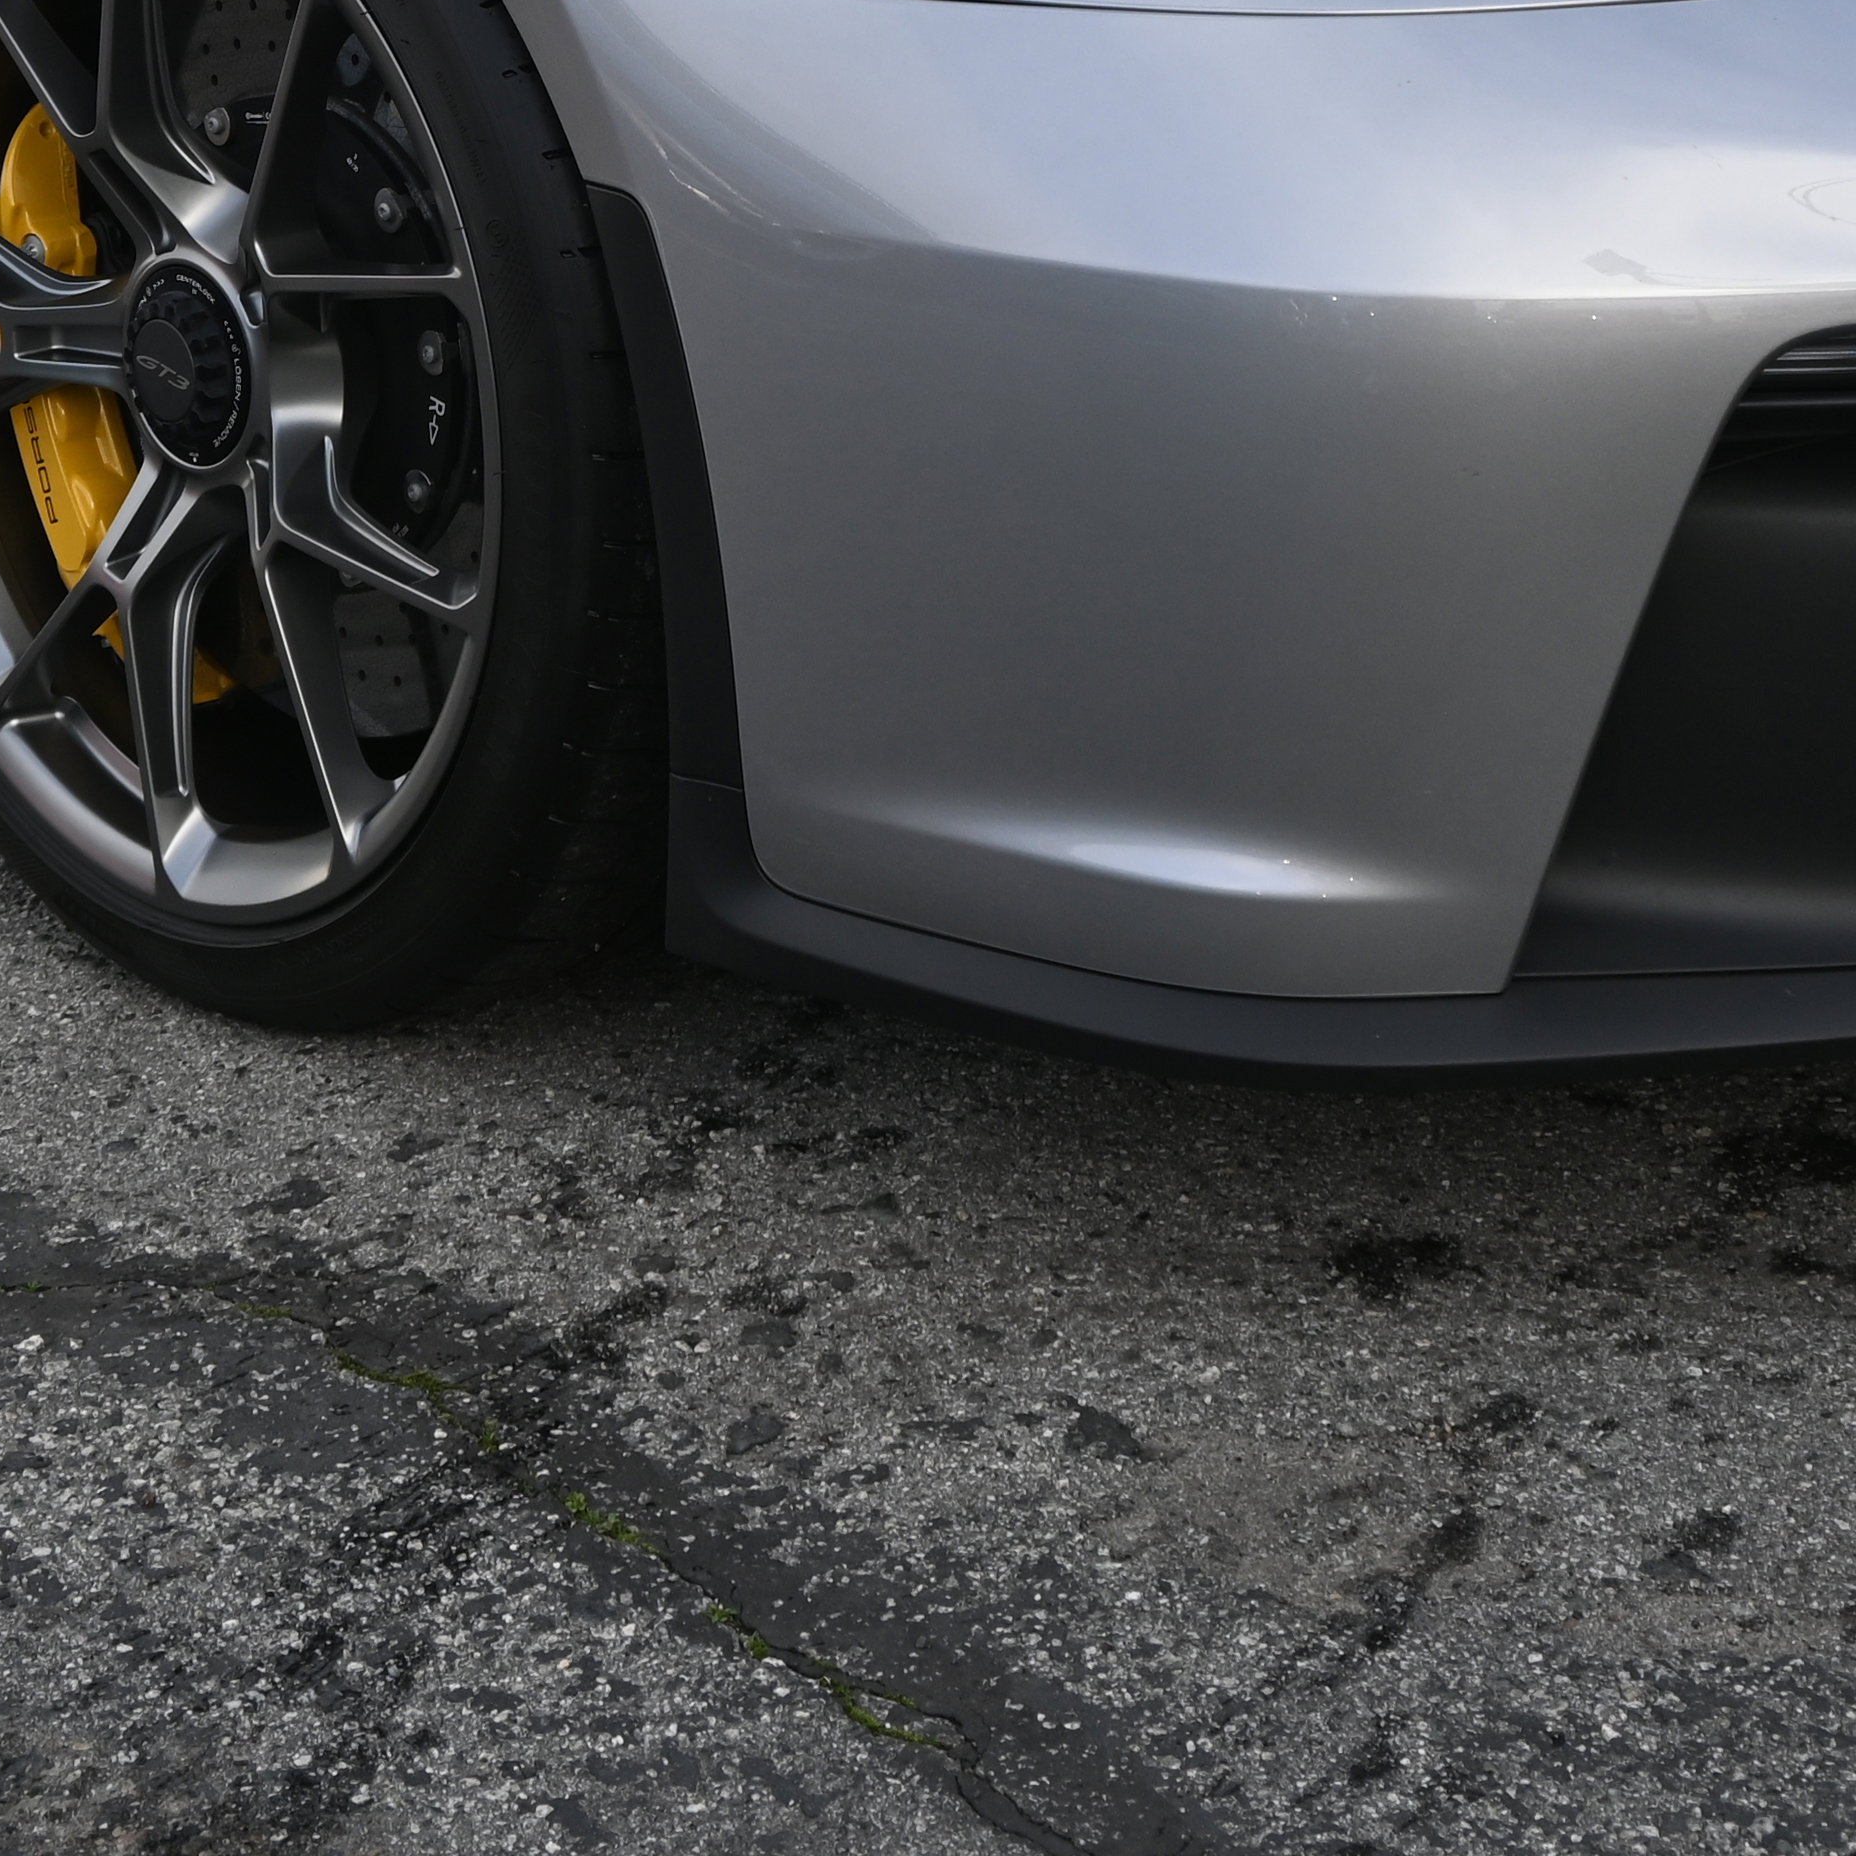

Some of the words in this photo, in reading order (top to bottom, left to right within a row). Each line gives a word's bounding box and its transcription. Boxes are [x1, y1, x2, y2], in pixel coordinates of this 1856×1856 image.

[176, 274, 215, 304] CENTERLOCK
[136, 355, 190, 390] GT3
[24, 406, 59, 524] PORS
